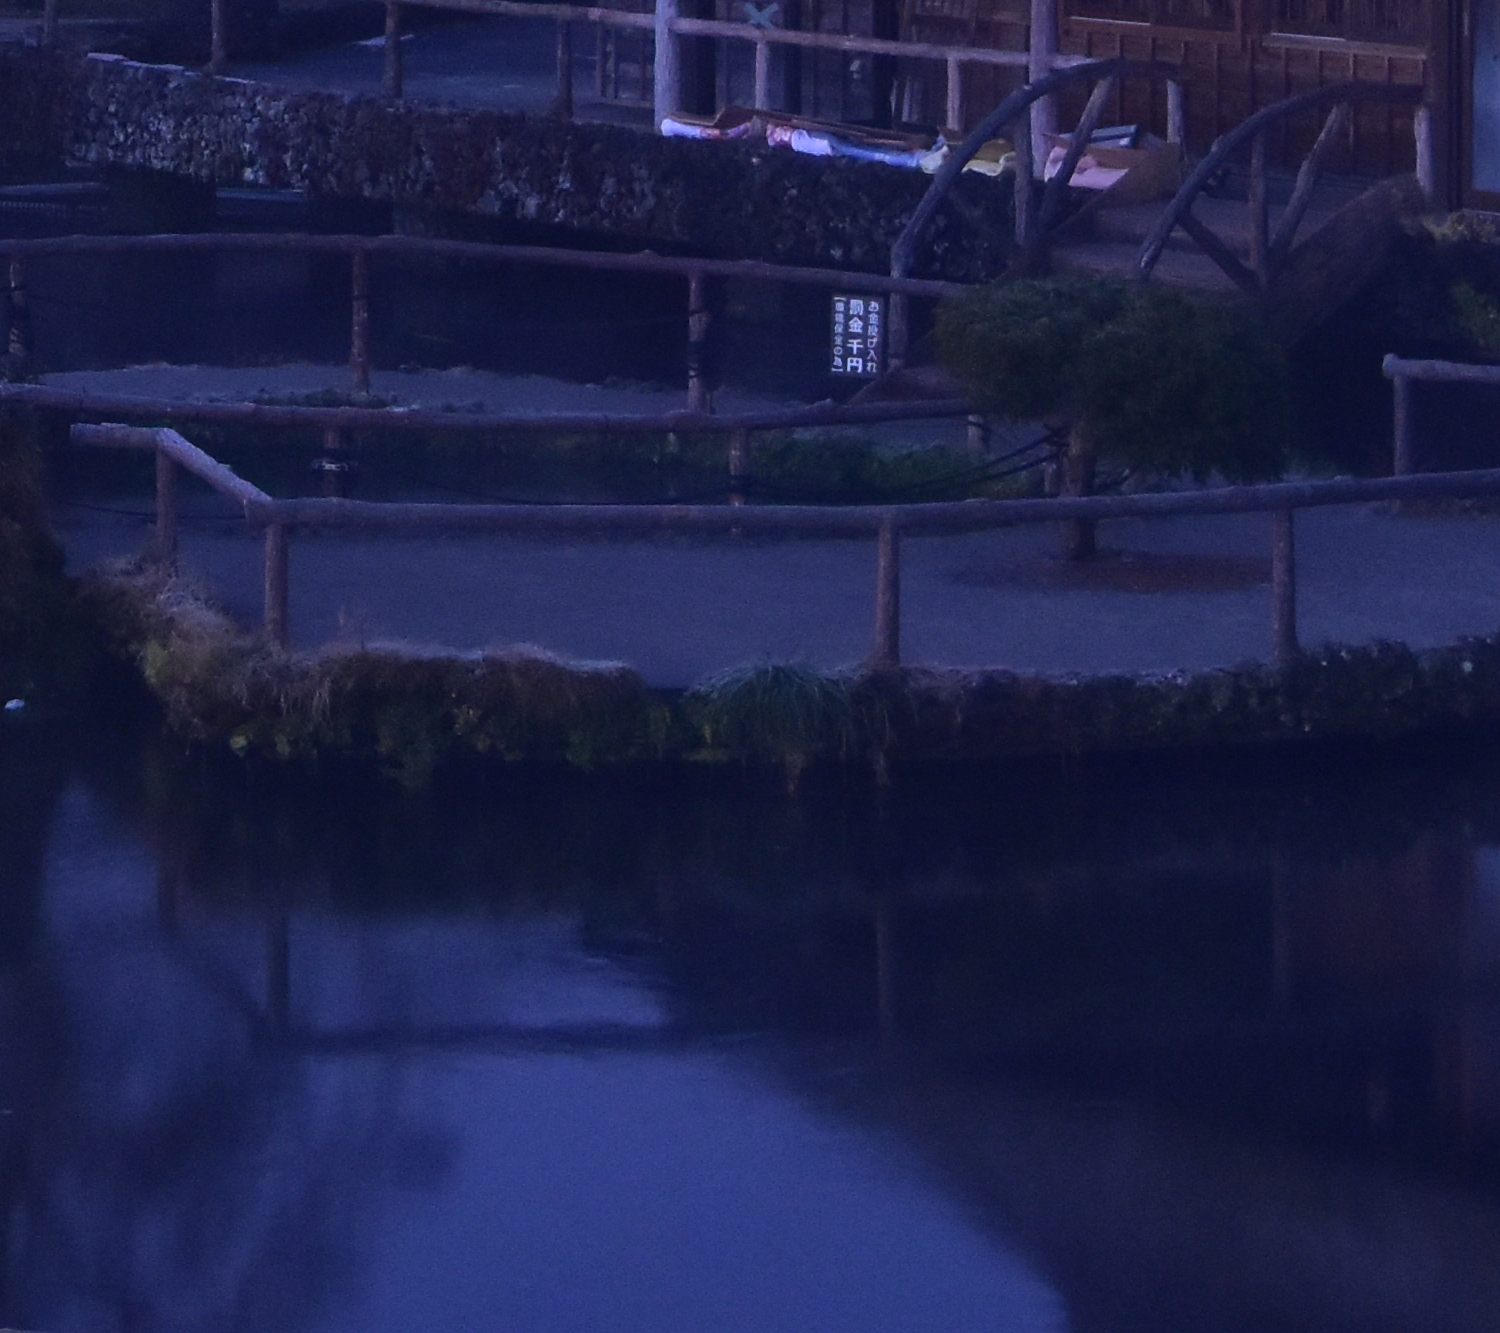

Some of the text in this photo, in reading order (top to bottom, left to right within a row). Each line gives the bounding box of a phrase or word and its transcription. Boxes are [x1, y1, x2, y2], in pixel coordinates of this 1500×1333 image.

[866, 300, 879, 373] お金投げ入れ
